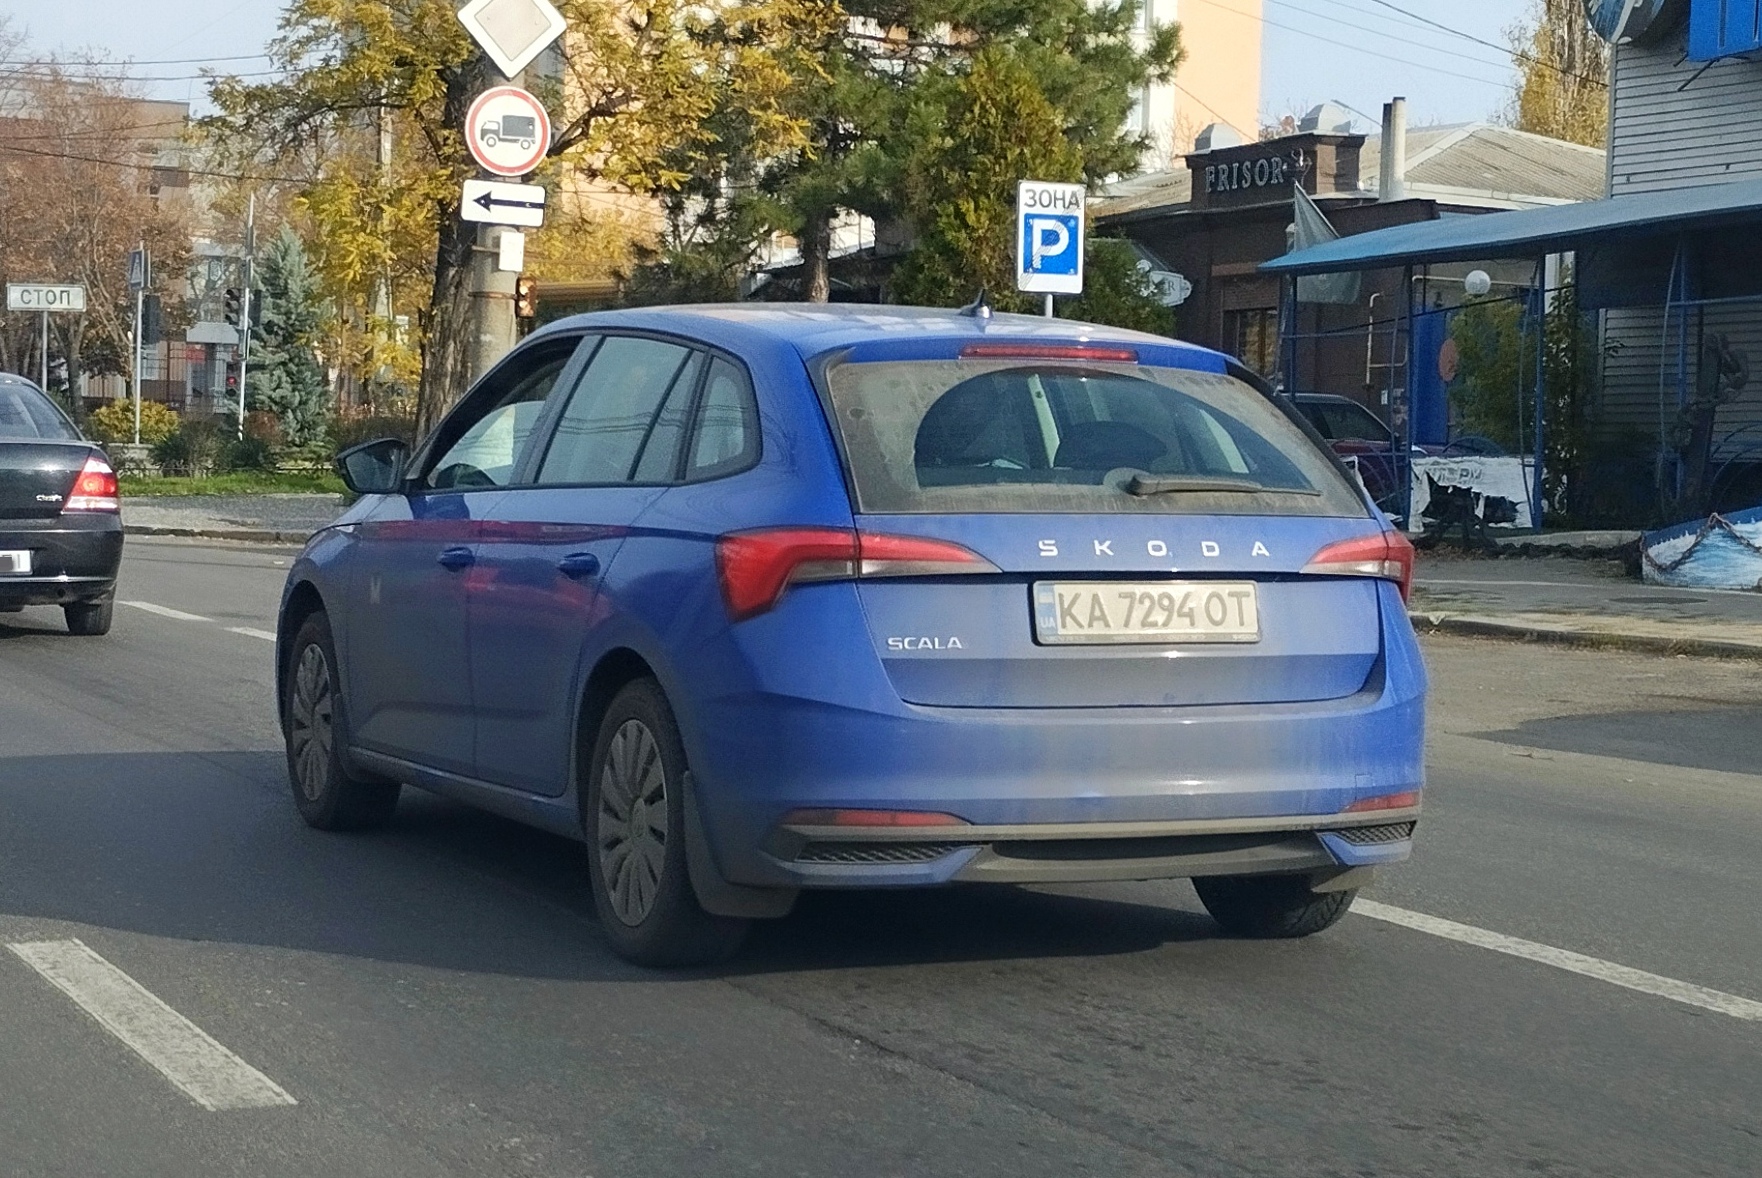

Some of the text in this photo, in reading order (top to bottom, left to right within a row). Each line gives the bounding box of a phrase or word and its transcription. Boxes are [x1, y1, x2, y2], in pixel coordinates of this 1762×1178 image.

[1205, 157, 1284, 193] FRISOR
[1024, 189, 1080, 209] ЗОНА
[1032, 219, 1070, 269] P
[20, 289, 70, 306] СТОП
[1038, 539, 1270, 557] SKODA
[1057, 591, 1251, 629] KA 7294 OT
[1040, 617, 1056, 629] UA
[887, 636, 963, 651] SCALA
